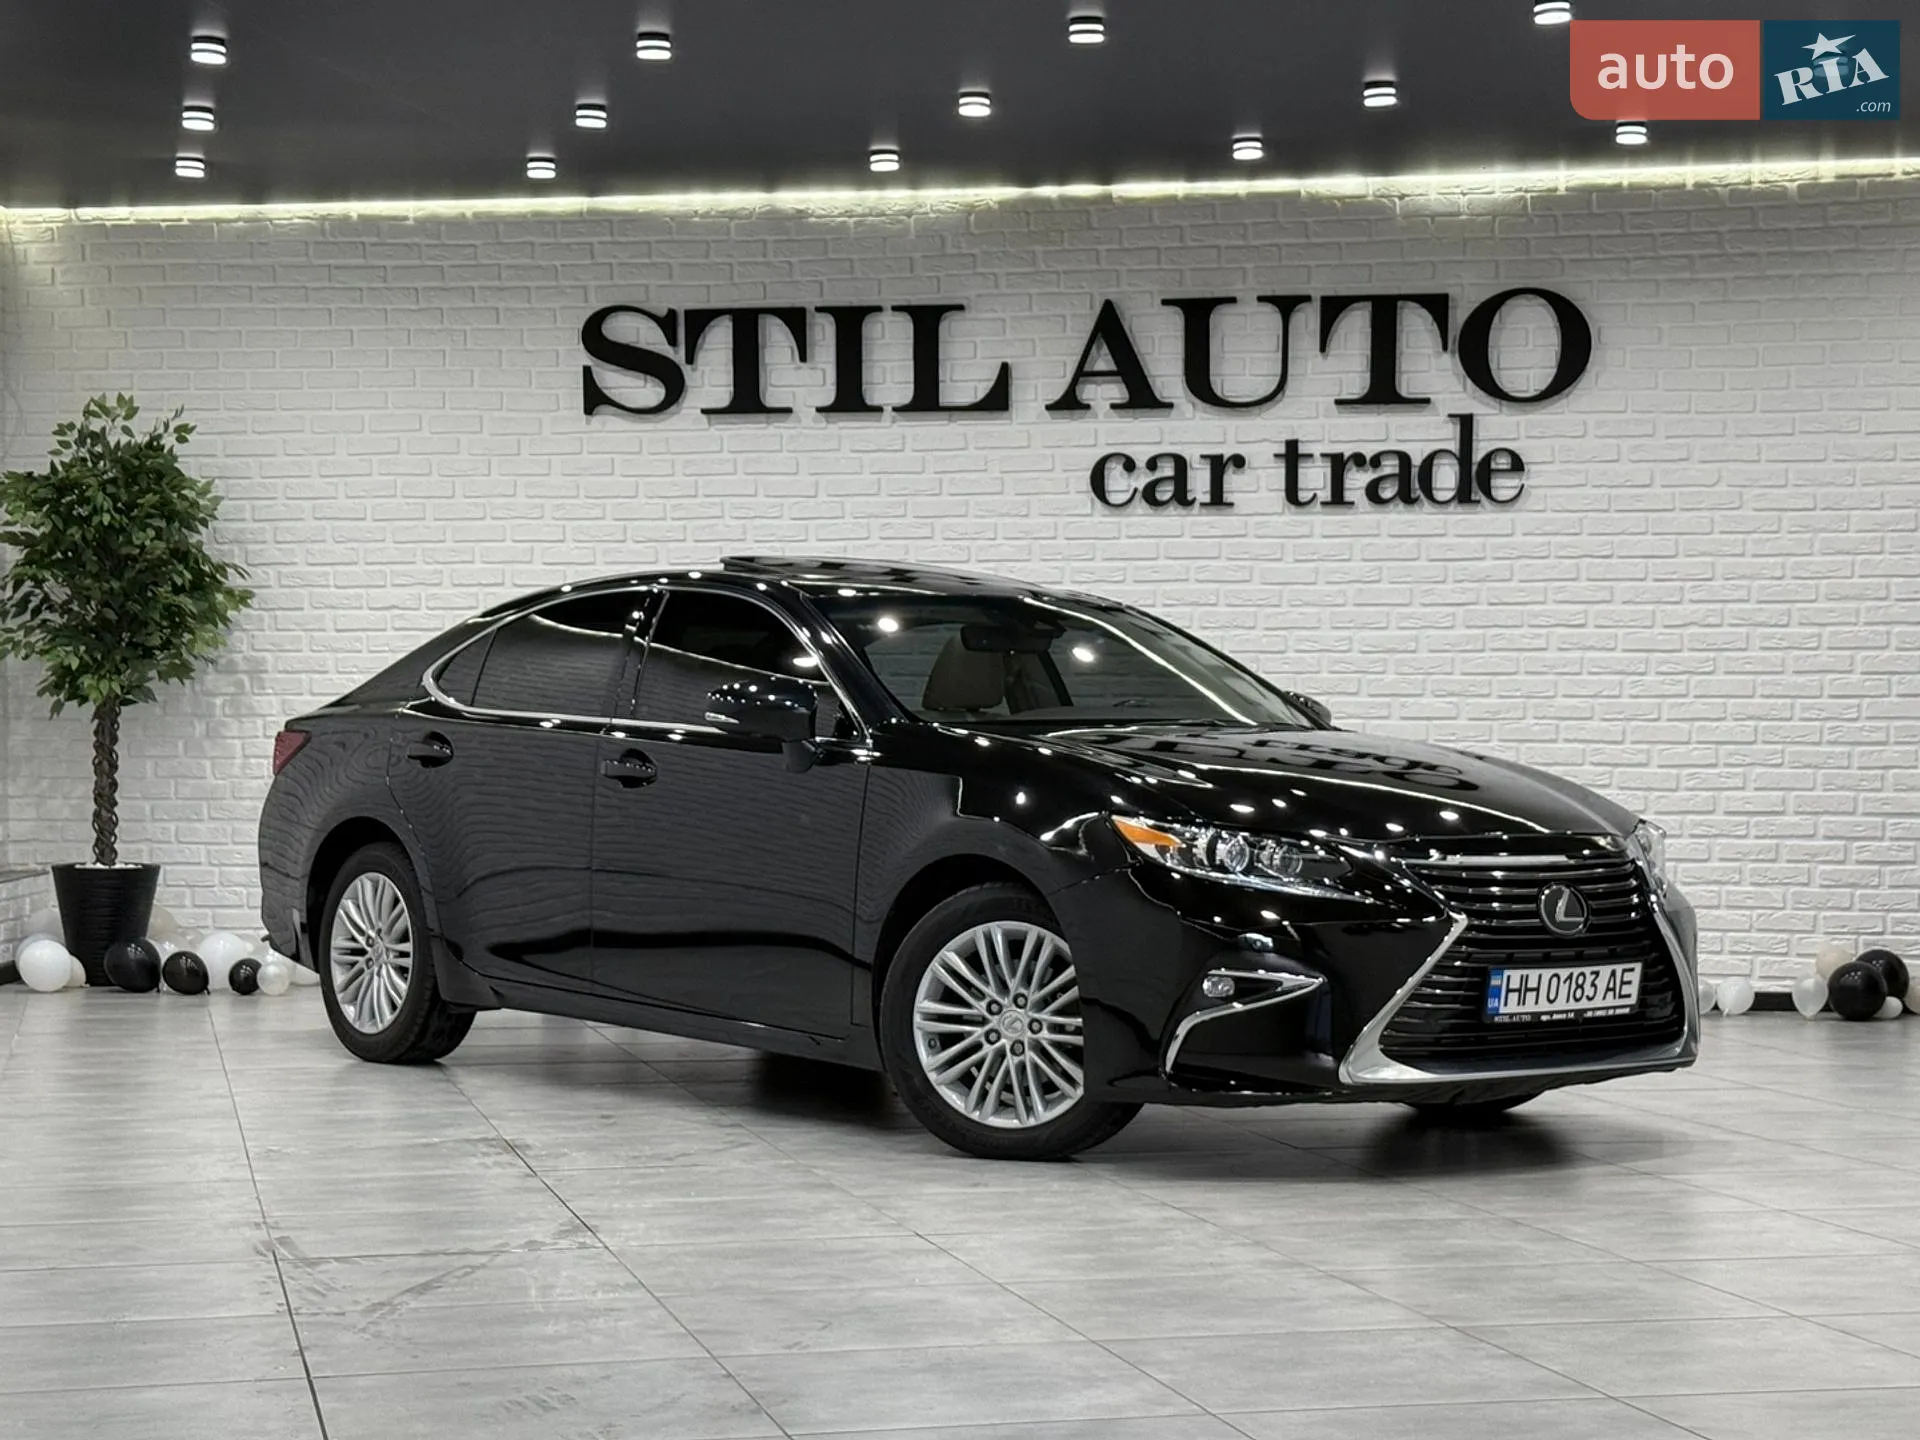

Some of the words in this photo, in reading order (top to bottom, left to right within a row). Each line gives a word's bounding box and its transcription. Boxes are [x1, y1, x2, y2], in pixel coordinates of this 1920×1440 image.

[581, 304, 1010, 416] STIL
[1045, 287, 1592, 411] AUTO
[1089, 452, 1247, 508] car
[1273, 413, 1527, 508] trade
[1487, 998, 1499, 1009] UA
[1503, 973, 1542, 1008] HH
[1546, 969, 1600, 1005] 0183
[1602, 967, 1636, 1001] AE
